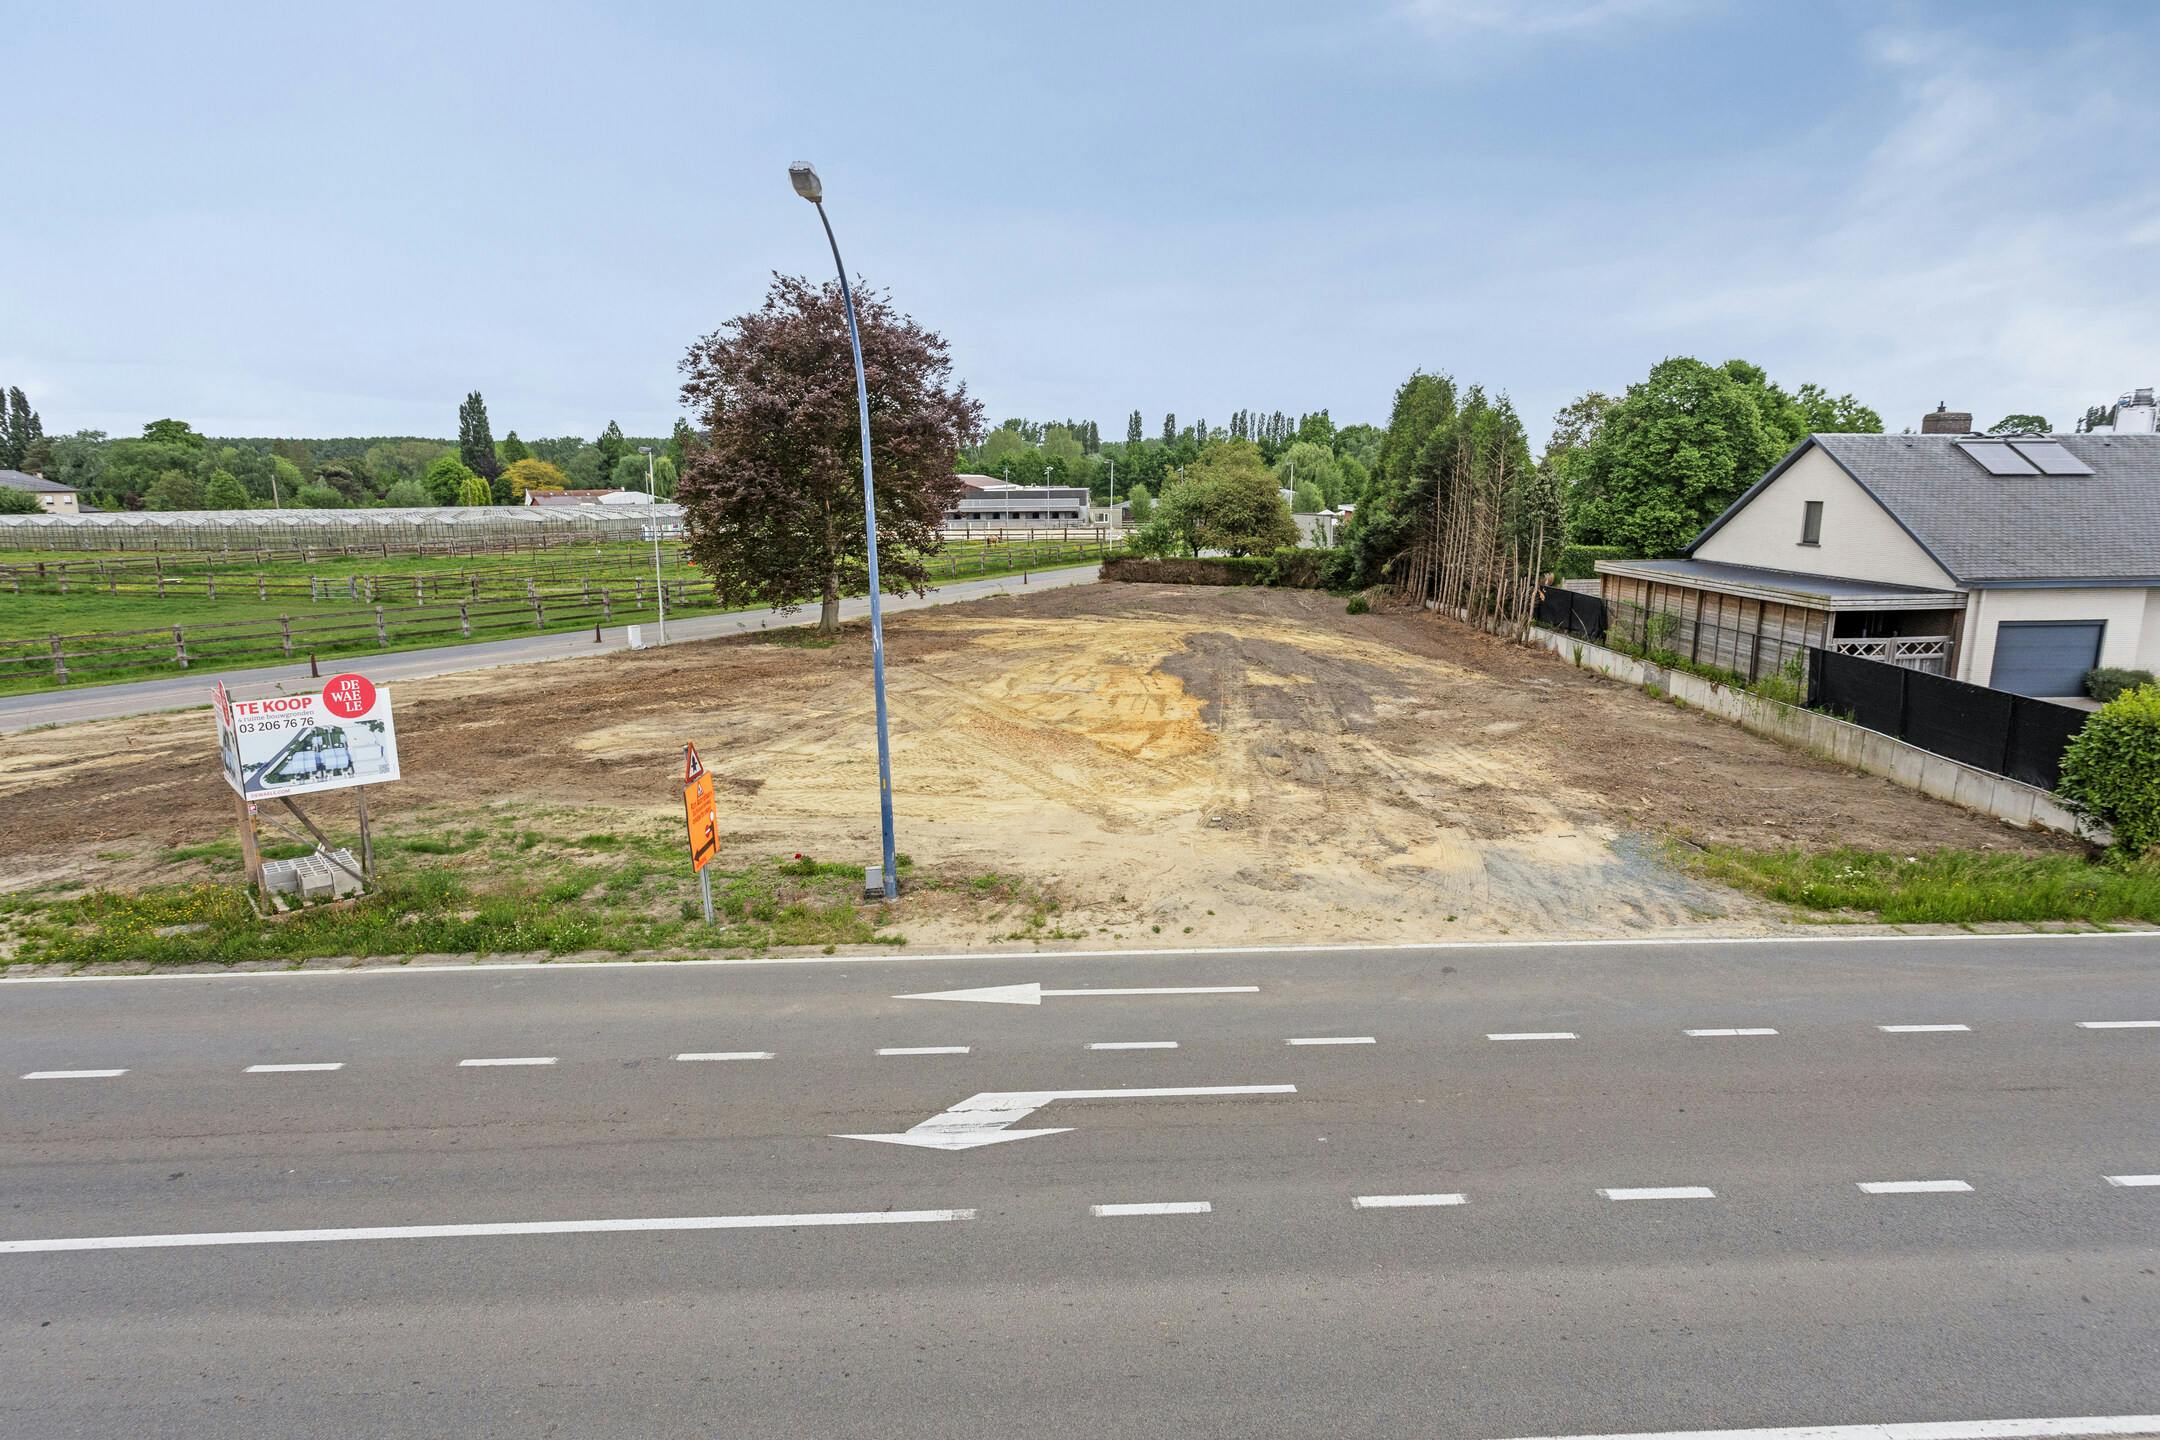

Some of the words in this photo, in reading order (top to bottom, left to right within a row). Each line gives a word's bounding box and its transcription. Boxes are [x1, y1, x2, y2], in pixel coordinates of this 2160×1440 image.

[341, 680, 360, 691] DE
[331, 690, 361, 702] WAE
[236, 702, 259, 715] TE
[262, 697, 312, 713] KOOP
[345, 701, 363, 712] LE
[266, 710, 315, 720] bouwgronden
[239, 723, 255, 734] 03
[258, 720, 281, 732] 206
[283, 718, 298, 729] 76
[300, 716, 314, 727] 76
